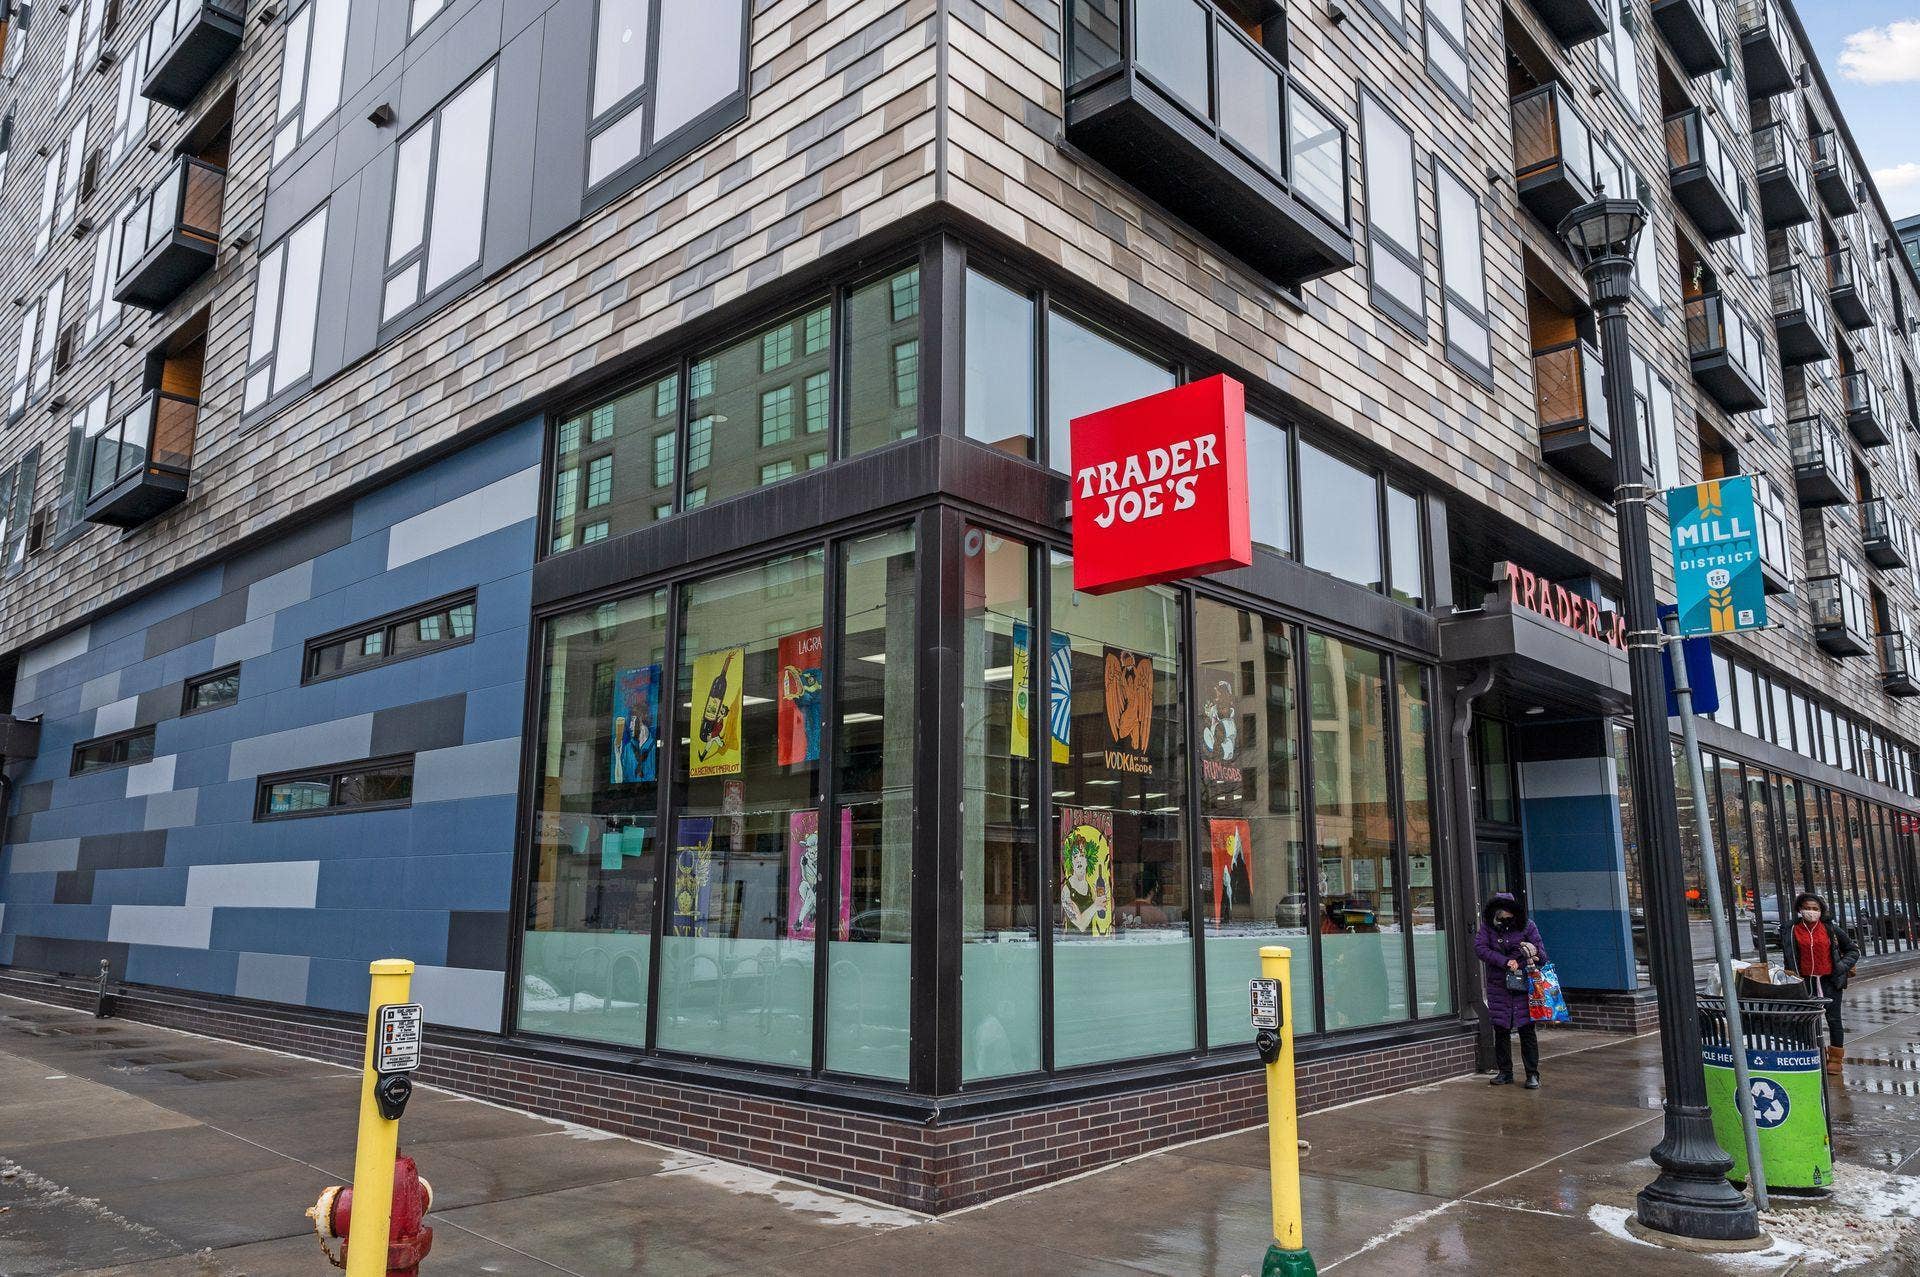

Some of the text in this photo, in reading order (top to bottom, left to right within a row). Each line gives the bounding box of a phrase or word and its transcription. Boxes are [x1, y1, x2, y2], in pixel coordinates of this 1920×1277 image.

[1077, 433, 1220, 499] TRADER
[1094, 474, 1199, 528] JOE'S
[1677, 517, 1750, 547] MILL
[1680, 551, 1753, 570] DISTRICT
[1504, 560, 1600, 641] TRADER
[1105, 750, 1135, 772] VODKA
[1134, 763, 1153, 775] GODS
[1777, 1056, 1811, 1066] RECYCLE
